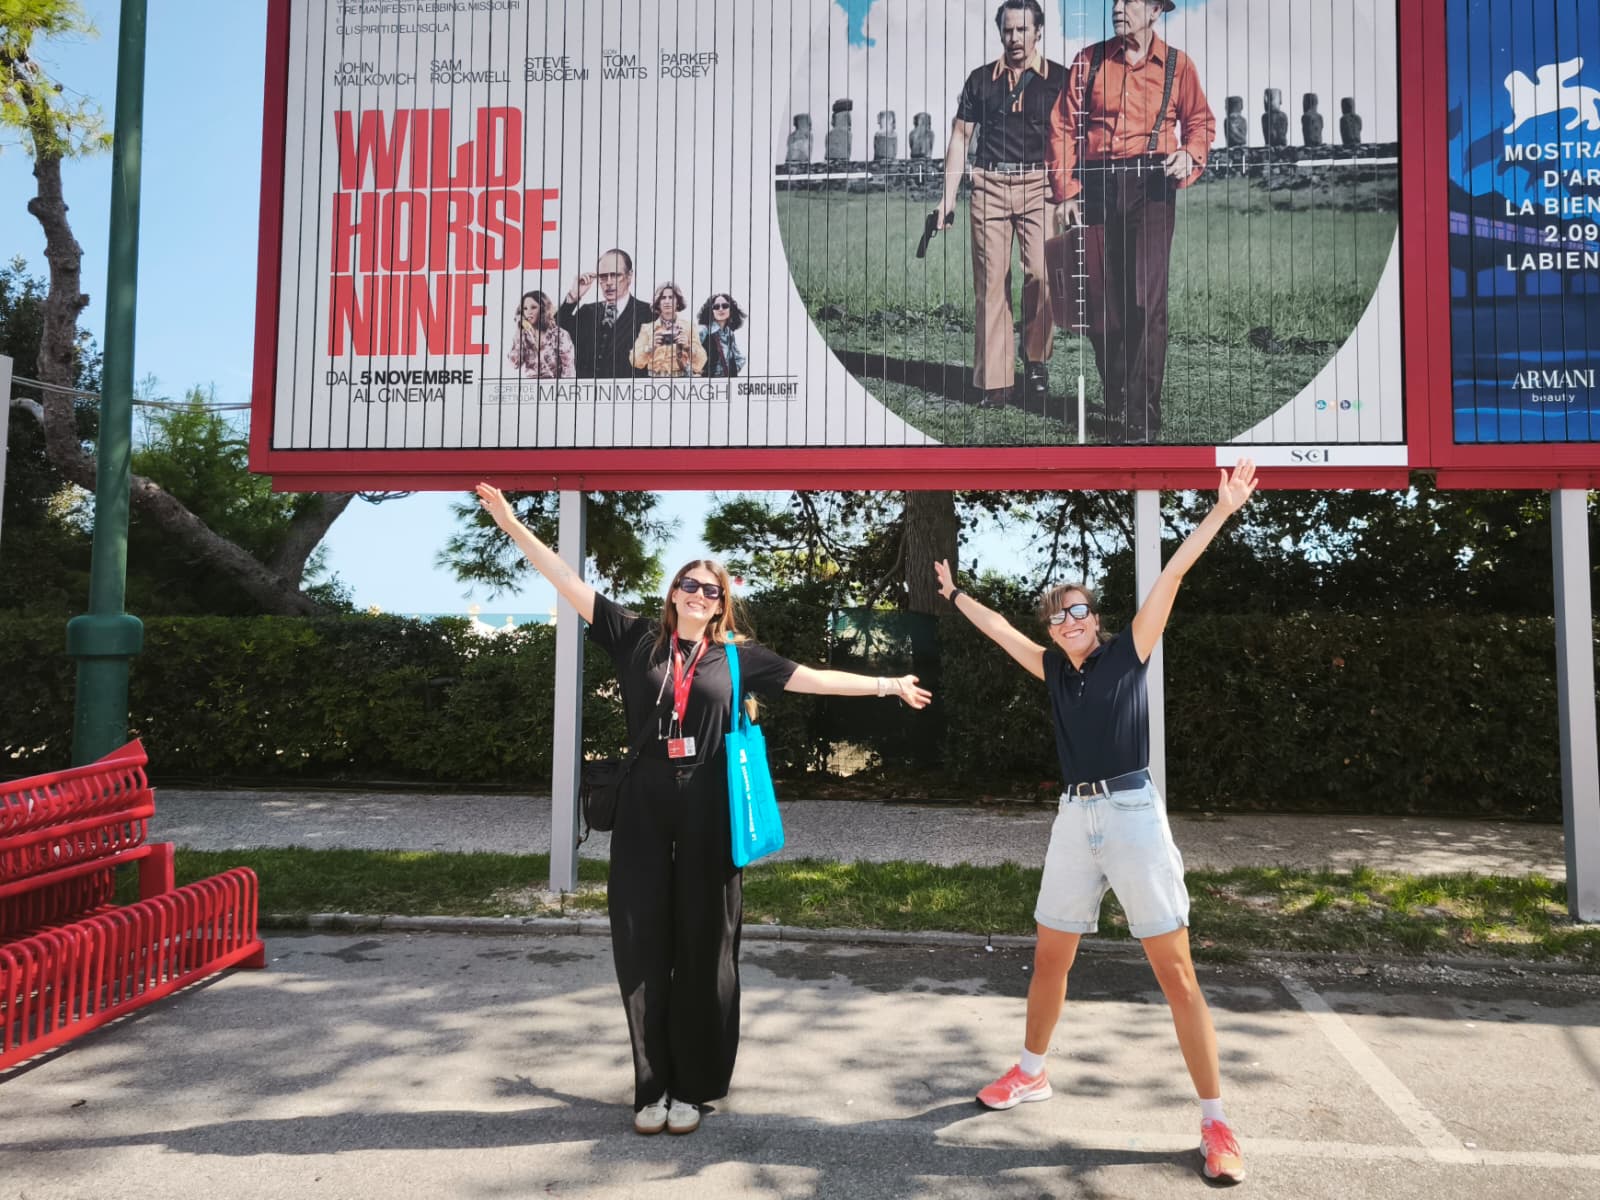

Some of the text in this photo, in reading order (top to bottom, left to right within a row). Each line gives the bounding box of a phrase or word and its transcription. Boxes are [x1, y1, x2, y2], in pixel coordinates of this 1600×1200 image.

[338, 5, 357, 14] TRE
[359, 4, 416, 14] MANIFESTI
[468, 0, 520, 12] MISSOURI
[336, 25, 353, 35] GLI
[354, 25, 390, 35] SPIRITI
[525, 56, 570, 69] STEVE
[603, 55, 636, 67] TOM
[661, 52, 719, 65] PARKER
[334, 62, 374, 74] JOHN
[430, 59, 462, 72] SAM
[661, 65, 710, 78] POSEY
[334, 73, 416, 87] MALKOVICH
[430, 71, 511, 84] ROCKWELL
[525, 68, 589, 81] BUSCEMI
[603, 67, 648, 80] WAITS
[334, 106, 522, 190] WILD
[1506, 196, 1600, 216] LA BIEN
[331, 188, 559, 272] HORSE
[1544, 224, 1598, 242] 2.09
[1507, 252, 1600, 271] LABIEN
[328, 273, 490, 357] NINE
[326, 370, 473, 386] DAL 5 NOVEMBRE
[1511, 369, 1597, 389] ARMANI
[353, 387, 445, 403] AL CINEMA
[539, 383, 729, 401] MARTIN McDONAGH
[737, 382, 798, 395] SEARCHLIGHT
[1531, 393, 1576, 403] beauty
